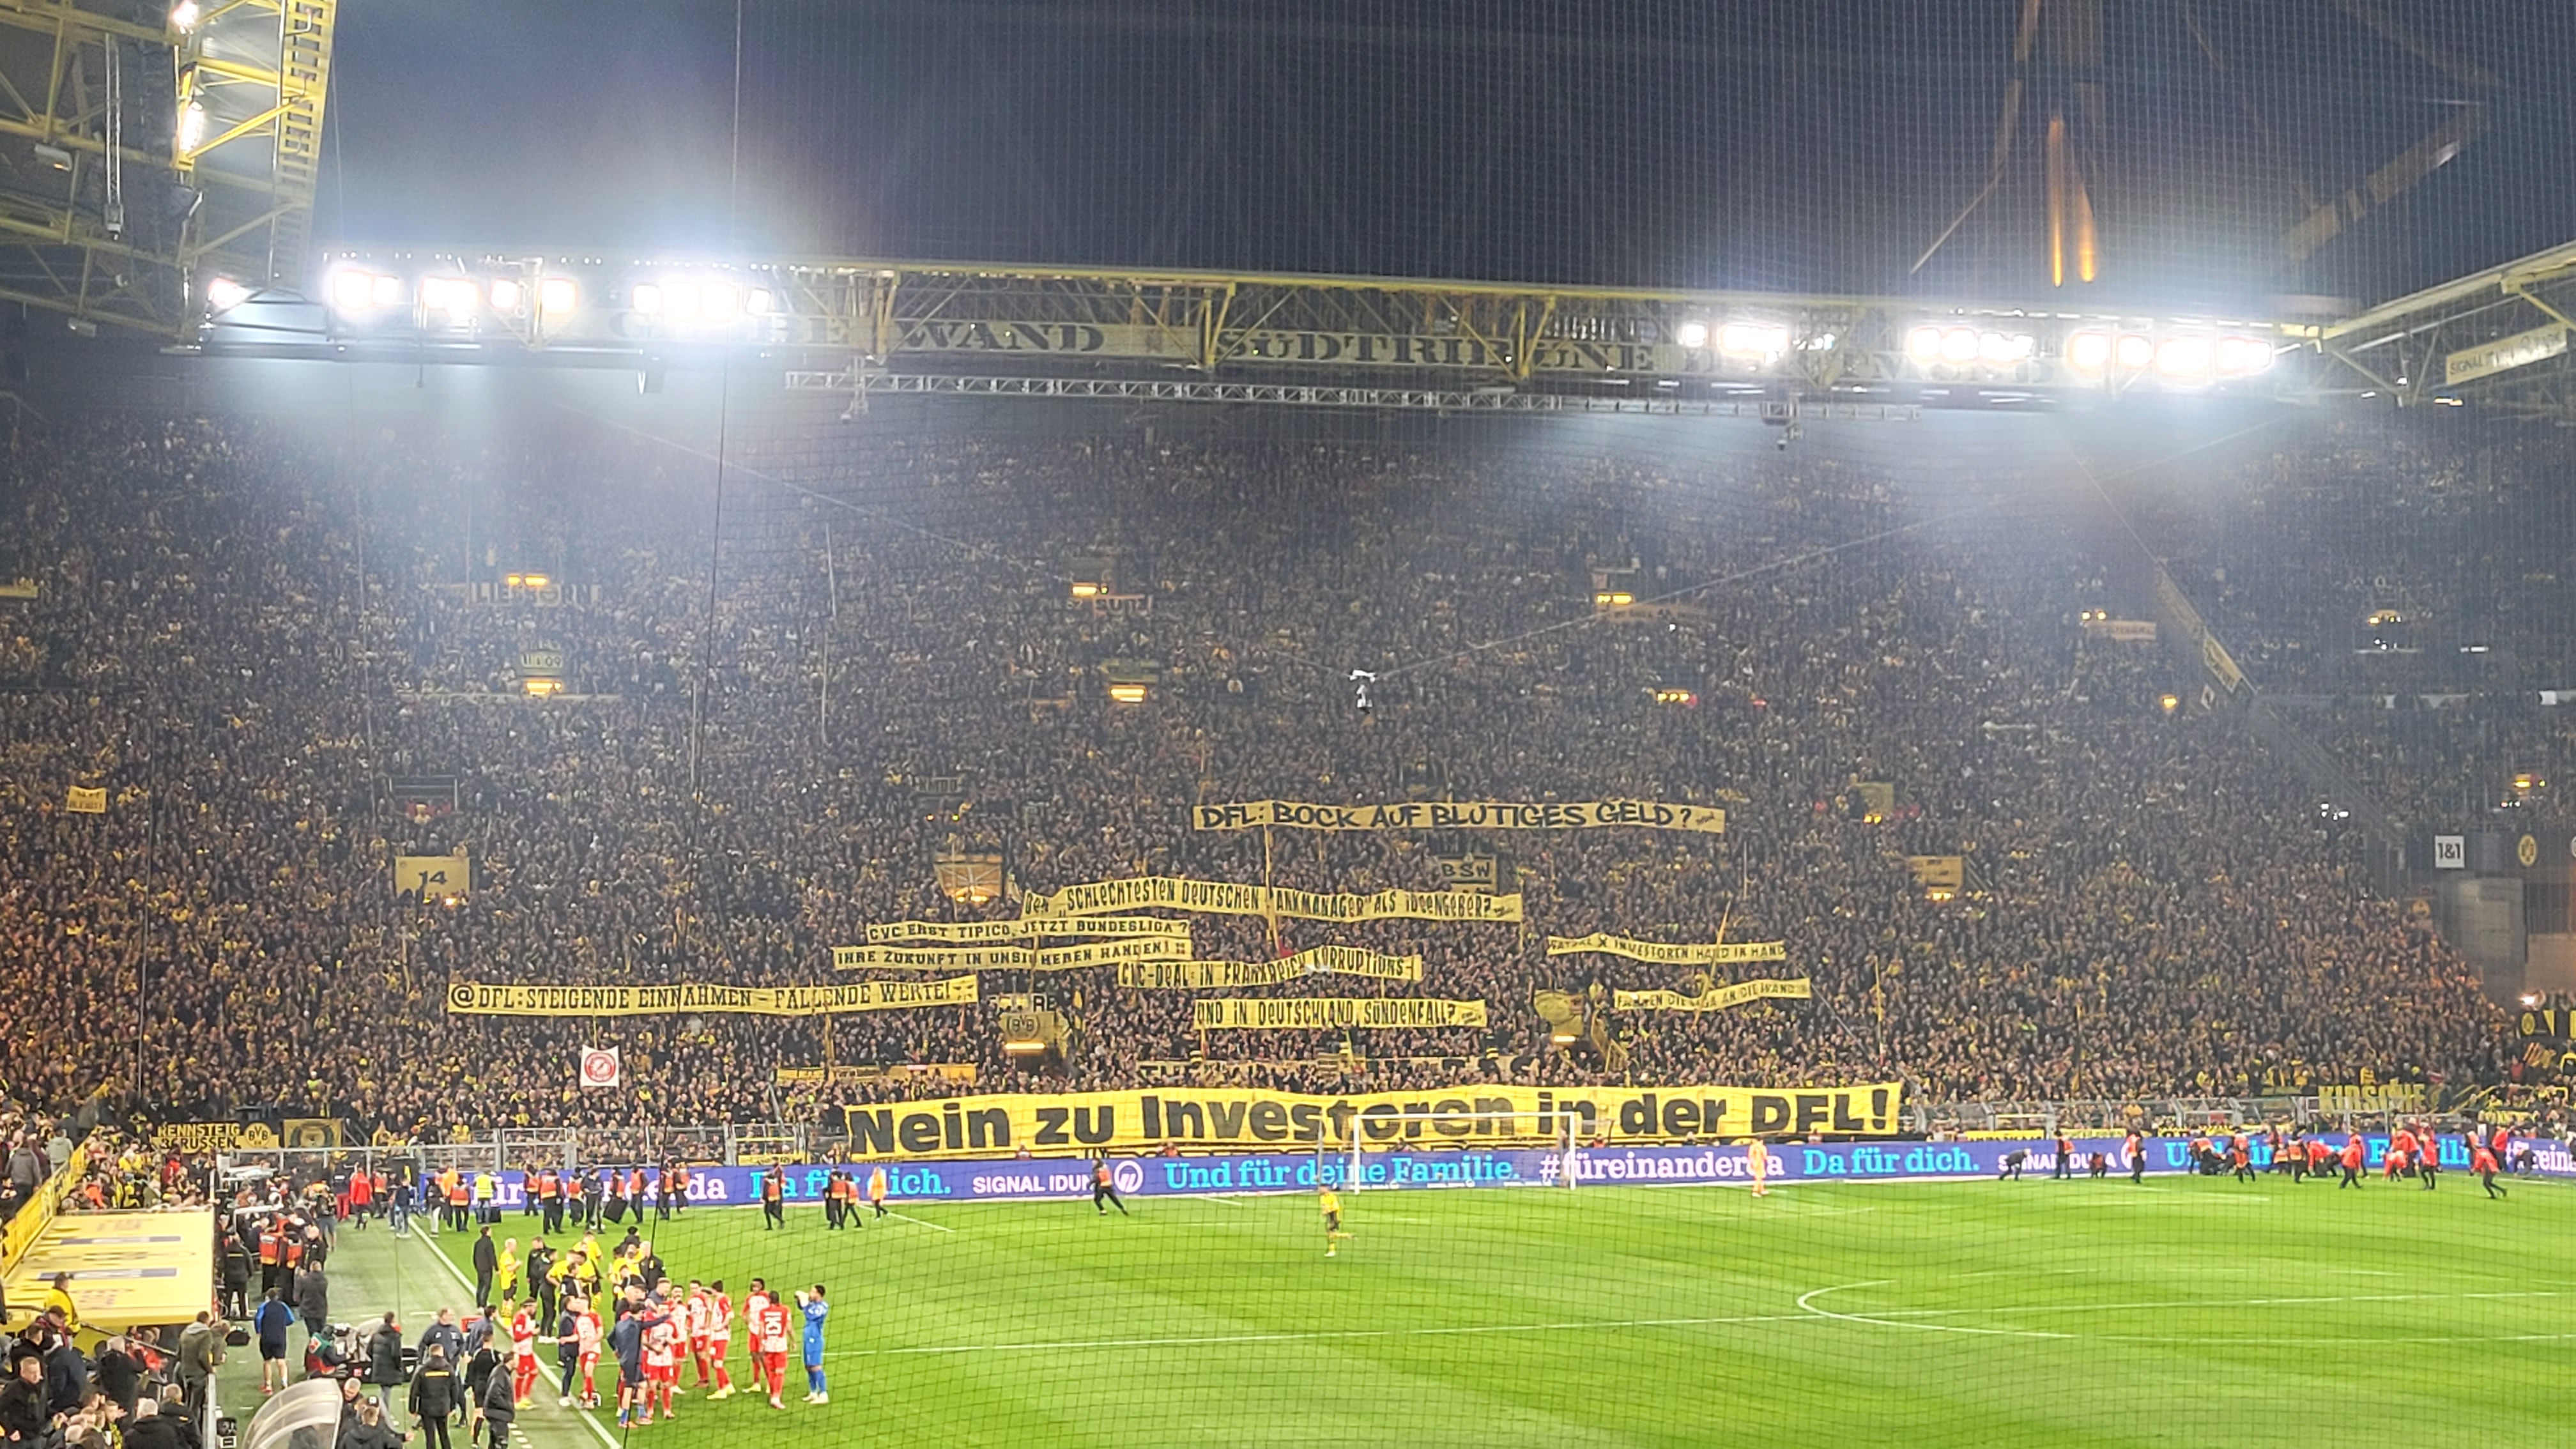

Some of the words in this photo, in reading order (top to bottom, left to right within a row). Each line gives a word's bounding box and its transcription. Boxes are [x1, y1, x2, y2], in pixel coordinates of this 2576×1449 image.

[896, 321, 1103, 352] WAND
[1201, 806, 1264, 827] DFL:
[1273, 804, 1361, 827] BOCK
[1371, 805, 1421, 827] AUF
[1430, 804, 1586, 827] BLUTIGES
[2438, 843, 2460, 859] 1&1
[418, 871, 448, 885] 14
[1374, 893, 1396, 915] ALS
[869, 927, 901, 940] CVC
[1020, 920, 1069, 934] JETZT
[1076, 920, 1173, 933] BUNDESLIGA
[838, 951, 876, 965] IHRE
[884, 951, 957, 965] ZUKUNFT
[965, 953, 982, 965] IN
[639, 986, 752, 1008] EINNAHMEN
[775, 985, 871, 1009] FALLENDE
[880, 981, 951, 1004] WERTE!
[848, 1103, 1011, 1155] Nein
[1035, 1105, 1115, 1145] zu
[1142, 1094, 1515, 1142] Investoren
[1538, 1092, 1597, 1136] in
[1620, 1092, 1727, 1136] der
[1752, 1089, 1888, 1133] DFL!
[1163, 1162, 1232, 1189] Und
[1238, 1159, 1291, 1187] für
[1296, 1158, 1386, 1186] deine
[1392, 1154, 1520, 1182] Familie.
[1803, 1149, 1847, 1176] Da
[1851, 1147, 1900, 1174] für
[1905, 1146, 1980, 1173] dich.
[972, 1175, 1046, 1193] SIGNAL
